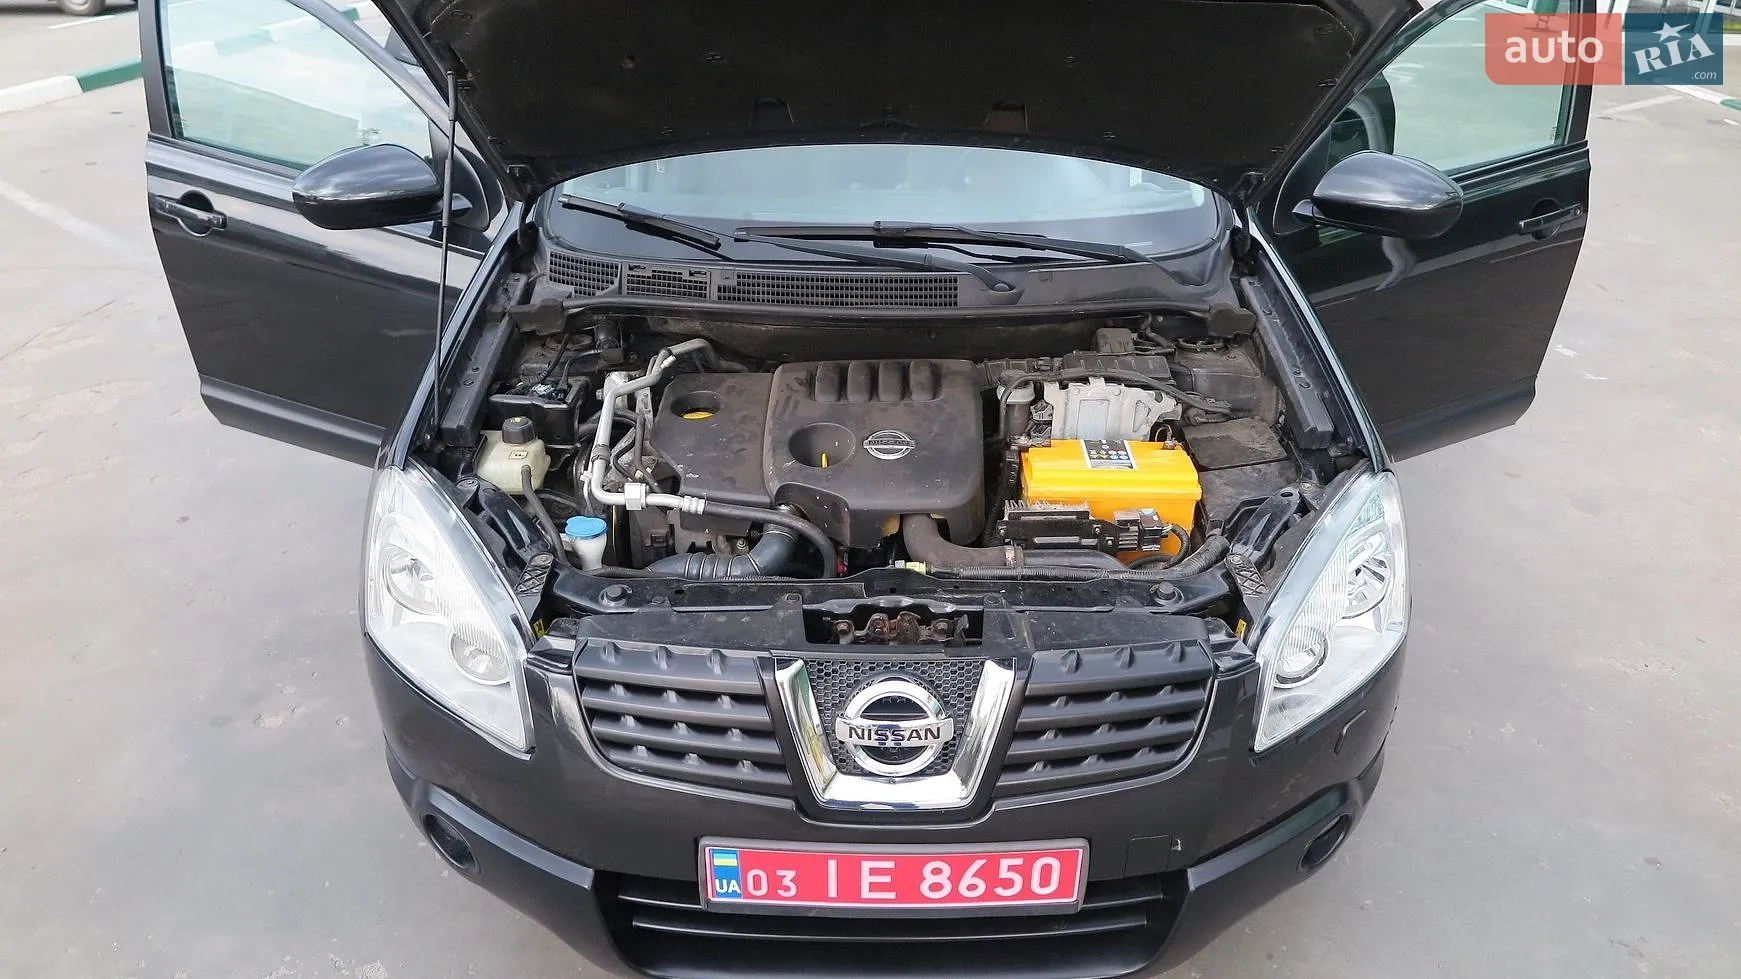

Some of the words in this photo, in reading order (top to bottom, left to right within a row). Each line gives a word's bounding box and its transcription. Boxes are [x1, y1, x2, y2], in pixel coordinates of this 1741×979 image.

[848, 726, 941, 741] NISSAN
[746, 868, 798, 897] 03
[826, 859, 896, 899] IE
[919, 856, 1062, 899] 8650
[715, 878, 741, 894] UA
